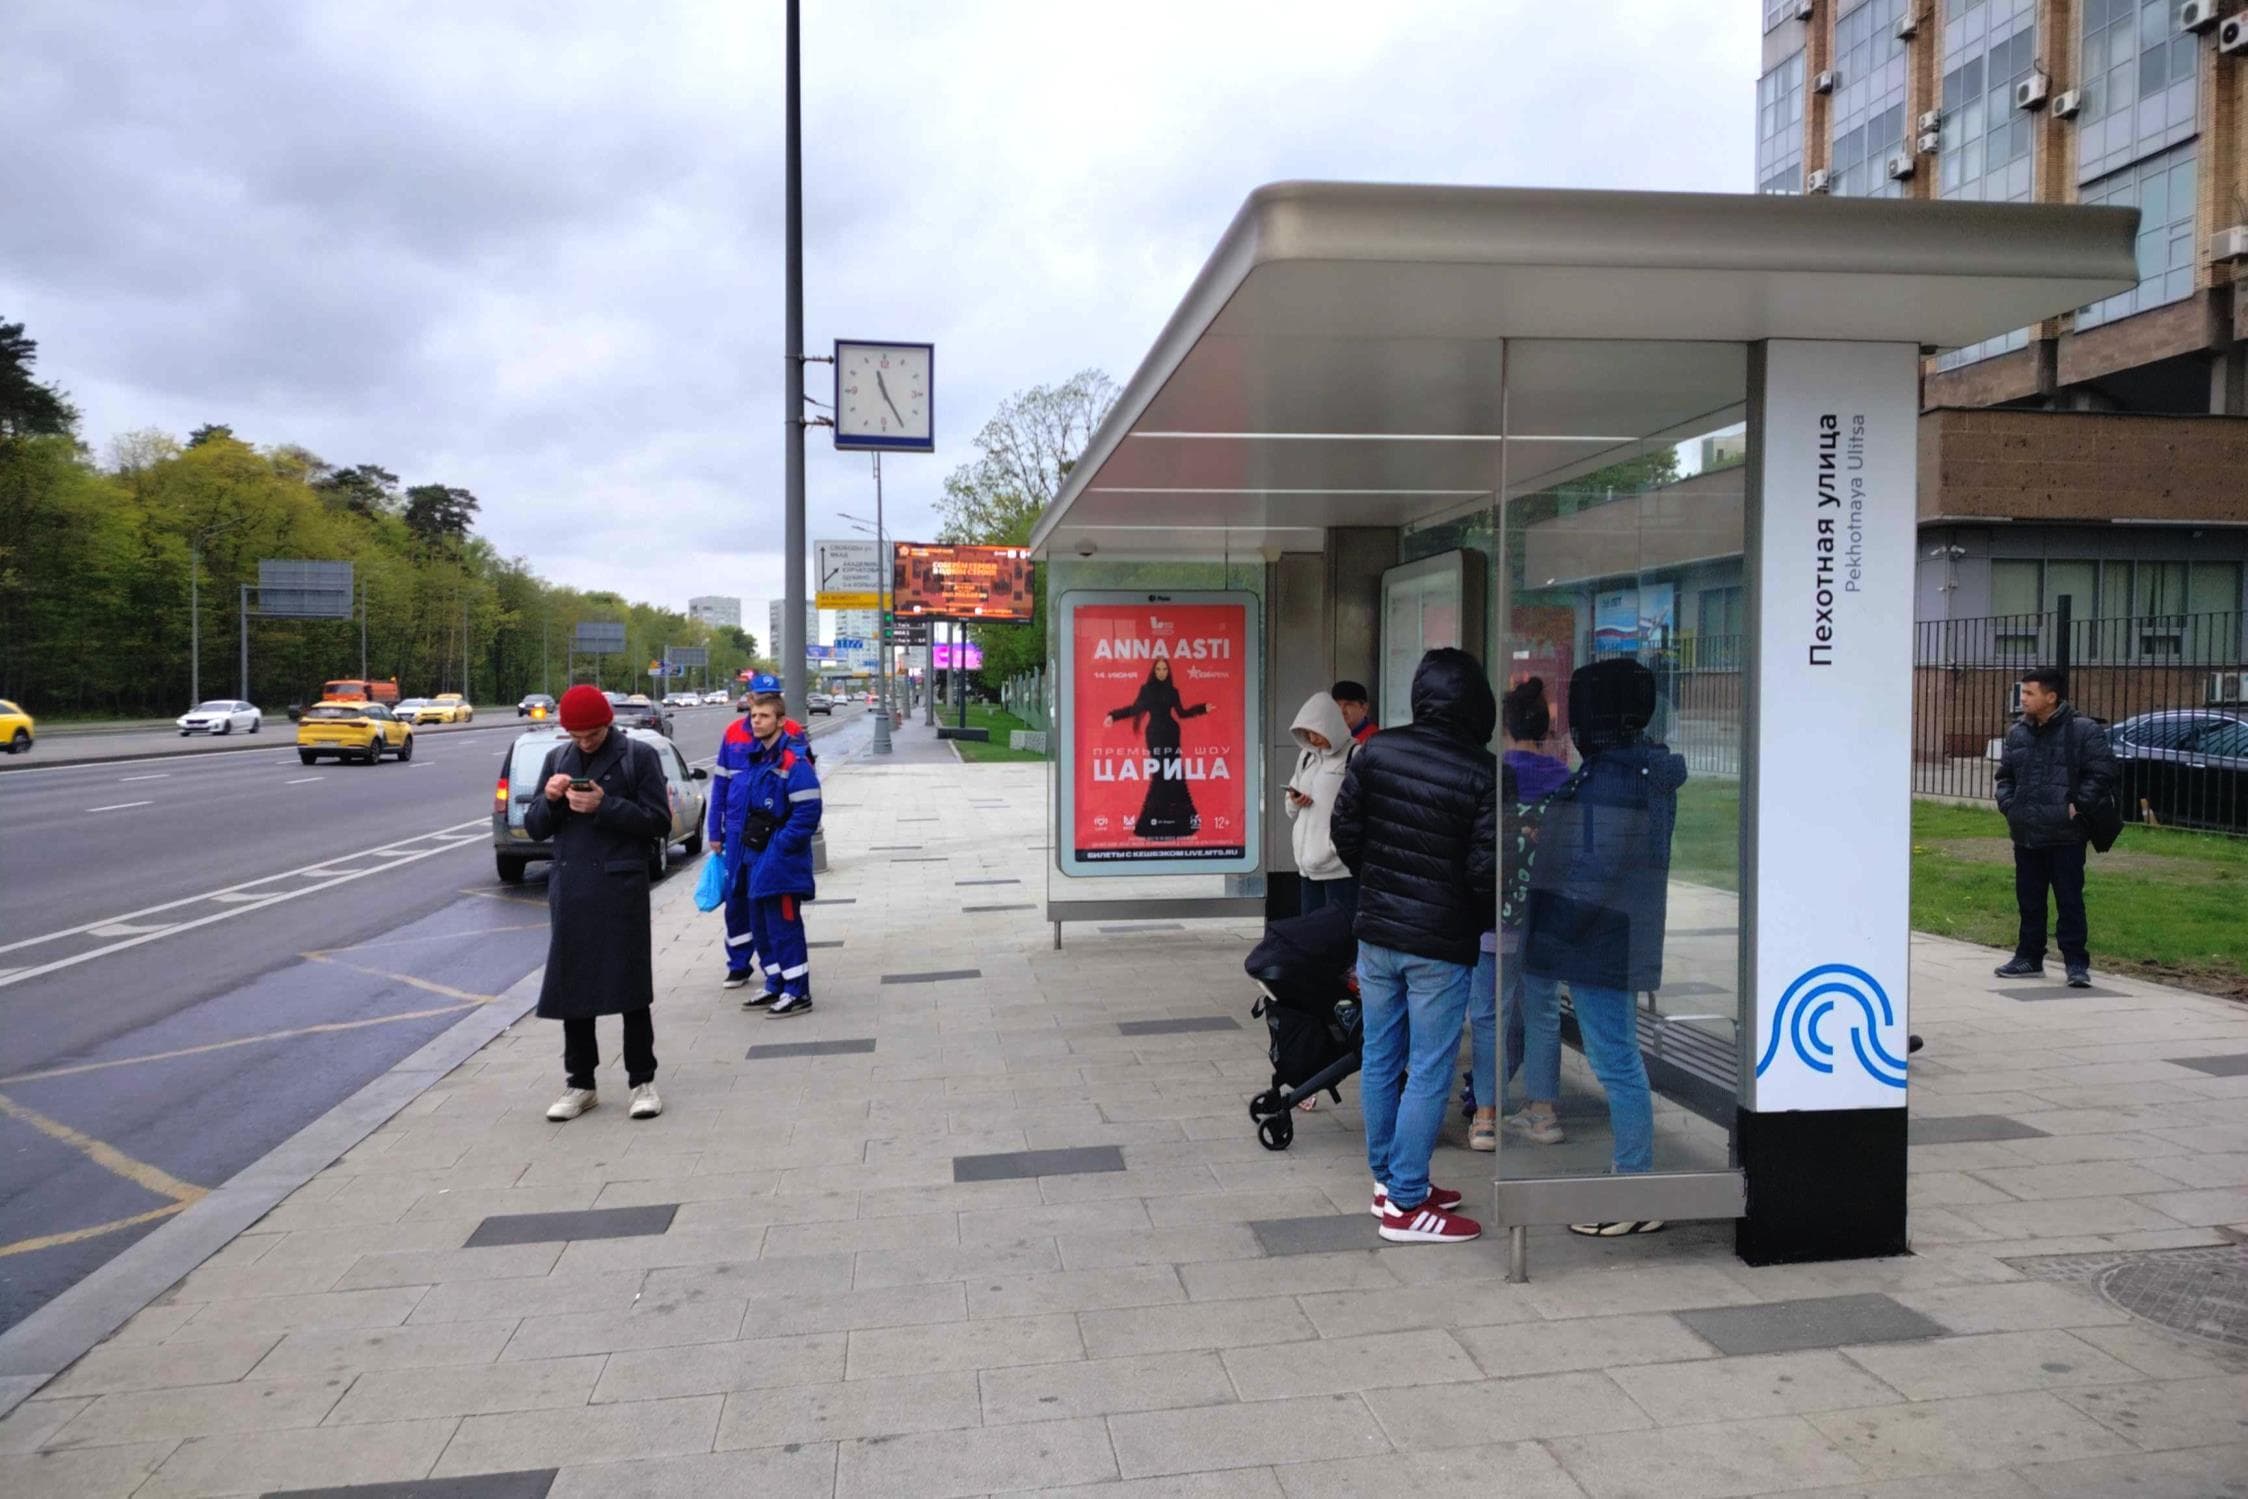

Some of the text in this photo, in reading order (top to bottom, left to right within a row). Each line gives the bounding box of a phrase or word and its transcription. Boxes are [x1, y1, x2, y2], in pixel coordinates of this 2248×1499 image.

[1845, 414, 1866, 592] Pekhotnaya Ulitsa
[1809, 413, 1840, 666] Пехотная улица
[1094, 638, 1230, 660] ANNA ASTI
[1093, 745, 1230, 756] ПРЕМЬЕРА ШОУ
[1093, 757, 1230, 782] ЦАРИЦА
[1214, 815, 1230, 830] 12+
[1087, 851, 1125, 859] БИЛЕТЫ
[1184, 848, 1238, 857] LIVE.MTS.RU
